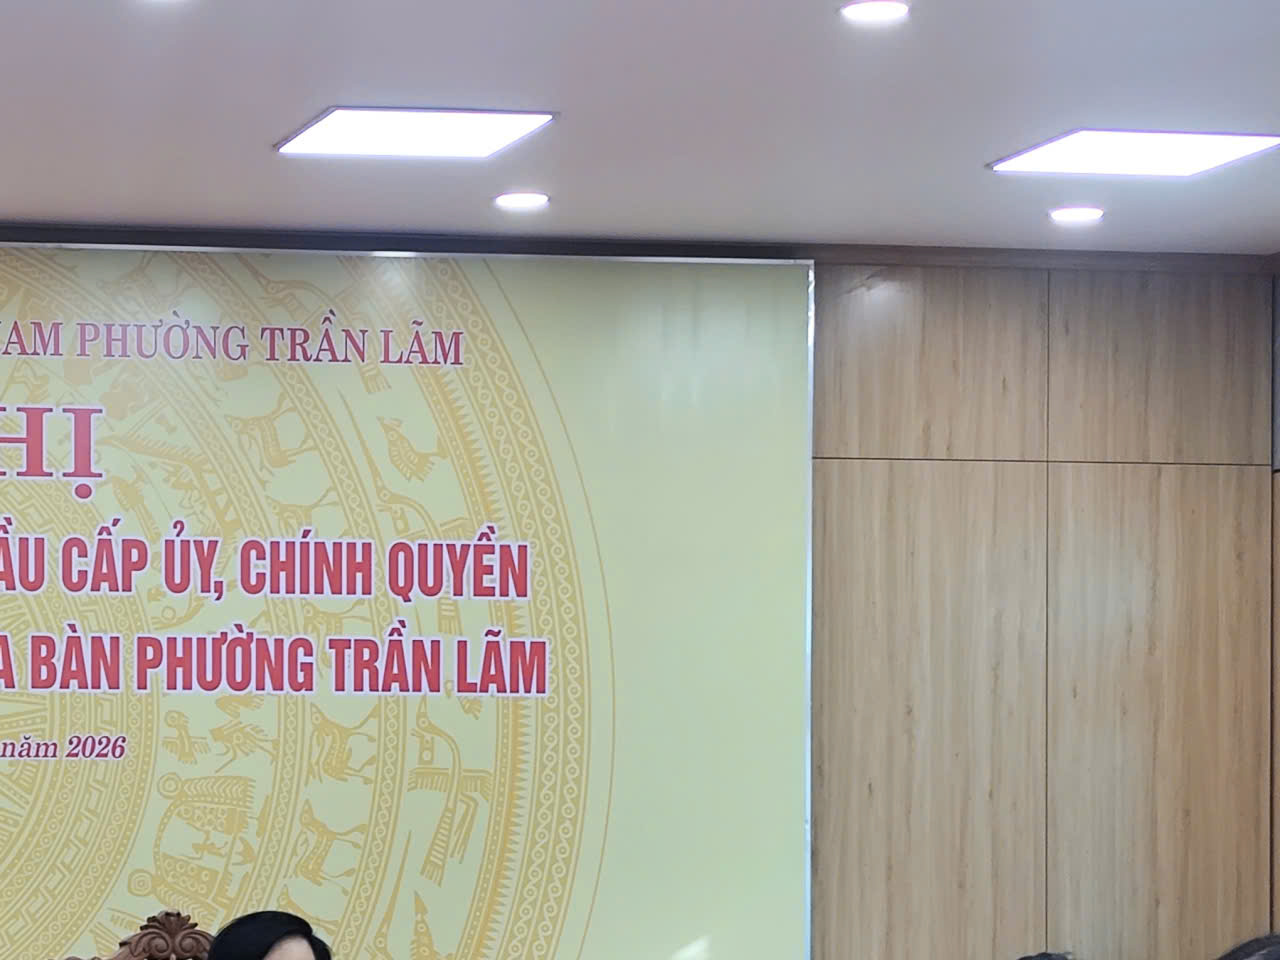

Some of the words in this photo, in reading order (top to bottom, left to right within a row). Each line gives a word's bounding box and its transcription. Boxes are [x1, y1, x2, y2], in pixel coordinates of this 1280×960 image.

[75, 310, 249, 362] PHƯỜNG
[260, 310, 370, 364] TRẦN
[380, 321, 464, 365] LÃM
[61, 518, 148, 594] CẤP
[163, 520, 224, 602] ỦY,
[239, 528, 372, 598] CHÍNH
[387, 525, 529, 603] QUYỀN
[31, 624, 120, 691] BÀN
[136, 624, 314, 692] PHƯỜNG
[329, 620, 441, 693] TRẦN
[458, 630, 547, 694] LÃM
[0, 738, 58, 760] năm
[65, 735, 127, 760] 2026
